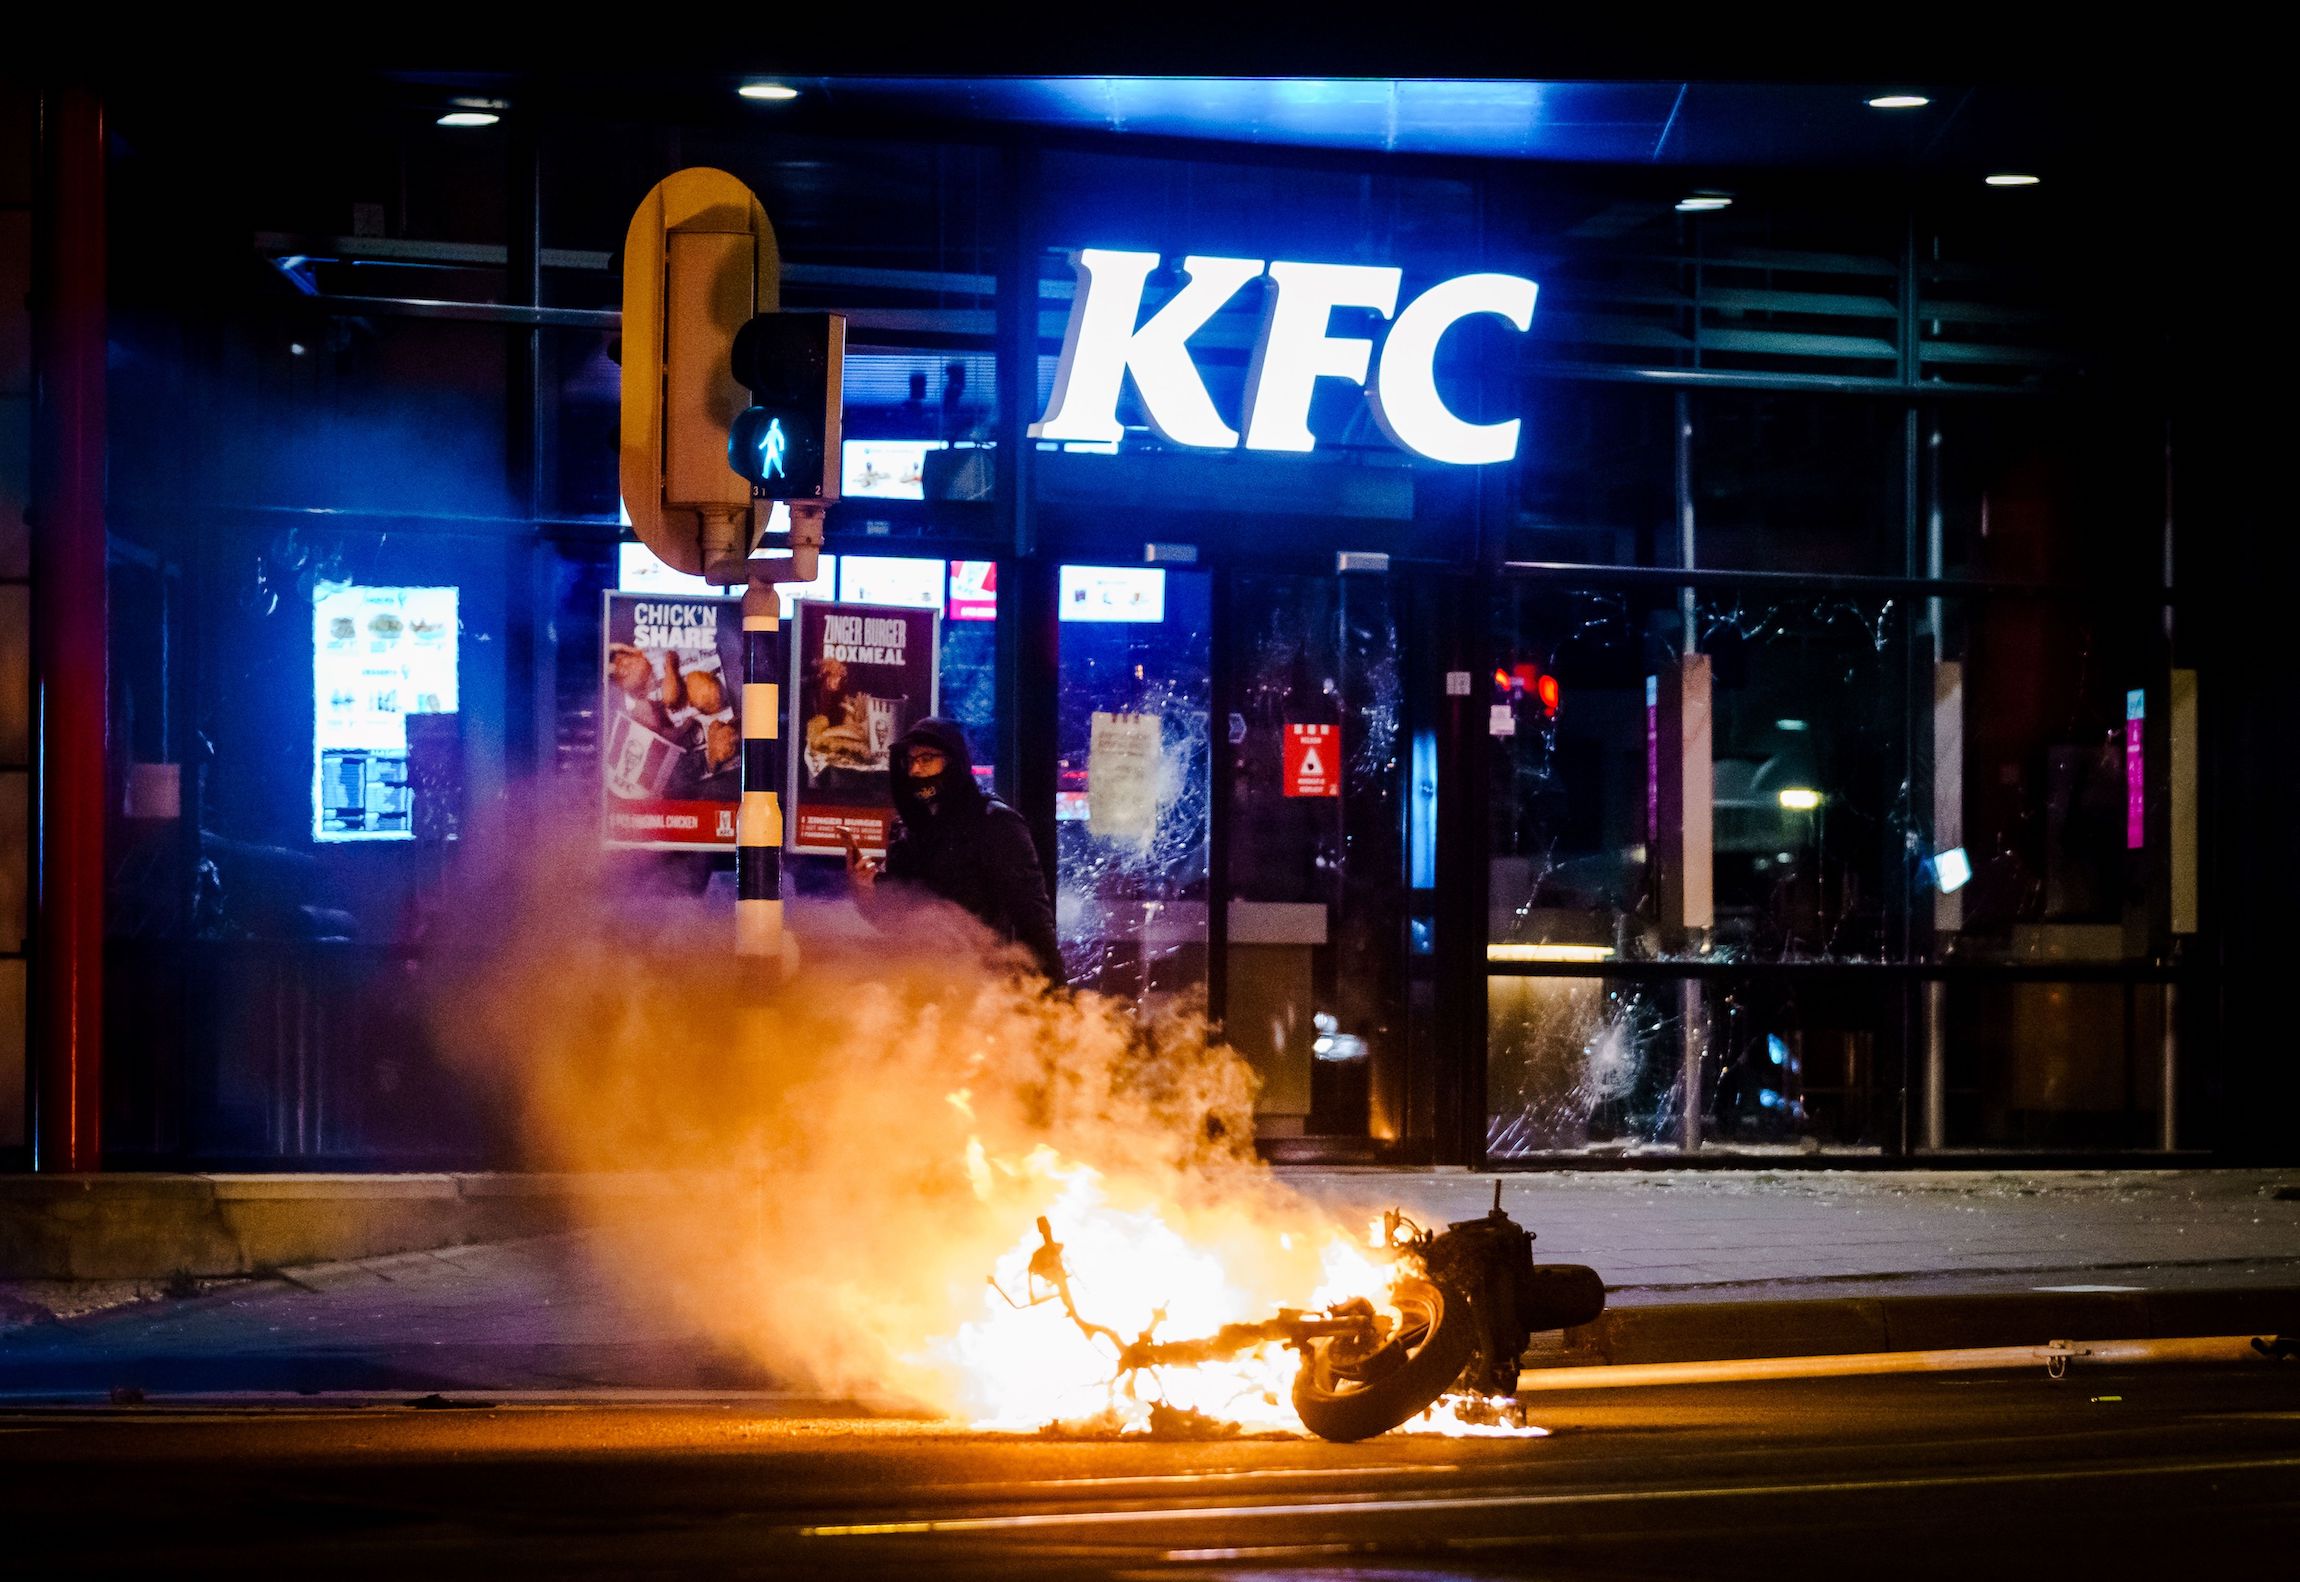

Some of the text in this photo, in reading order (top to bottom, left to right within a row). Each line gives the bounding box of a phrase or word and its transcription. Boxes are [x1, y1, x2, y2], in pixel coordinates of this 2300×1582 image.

[1028, 248, 1539, 465] KFC
[814, 484, 821, 496] 2
[634, 602, 717, 627] CHICK'N
[633, 624, 718, 650] SHARE
[823, 614, 907, 649] ZINGER BURGER
[823, 644, 906, 666] BOXMEAL
